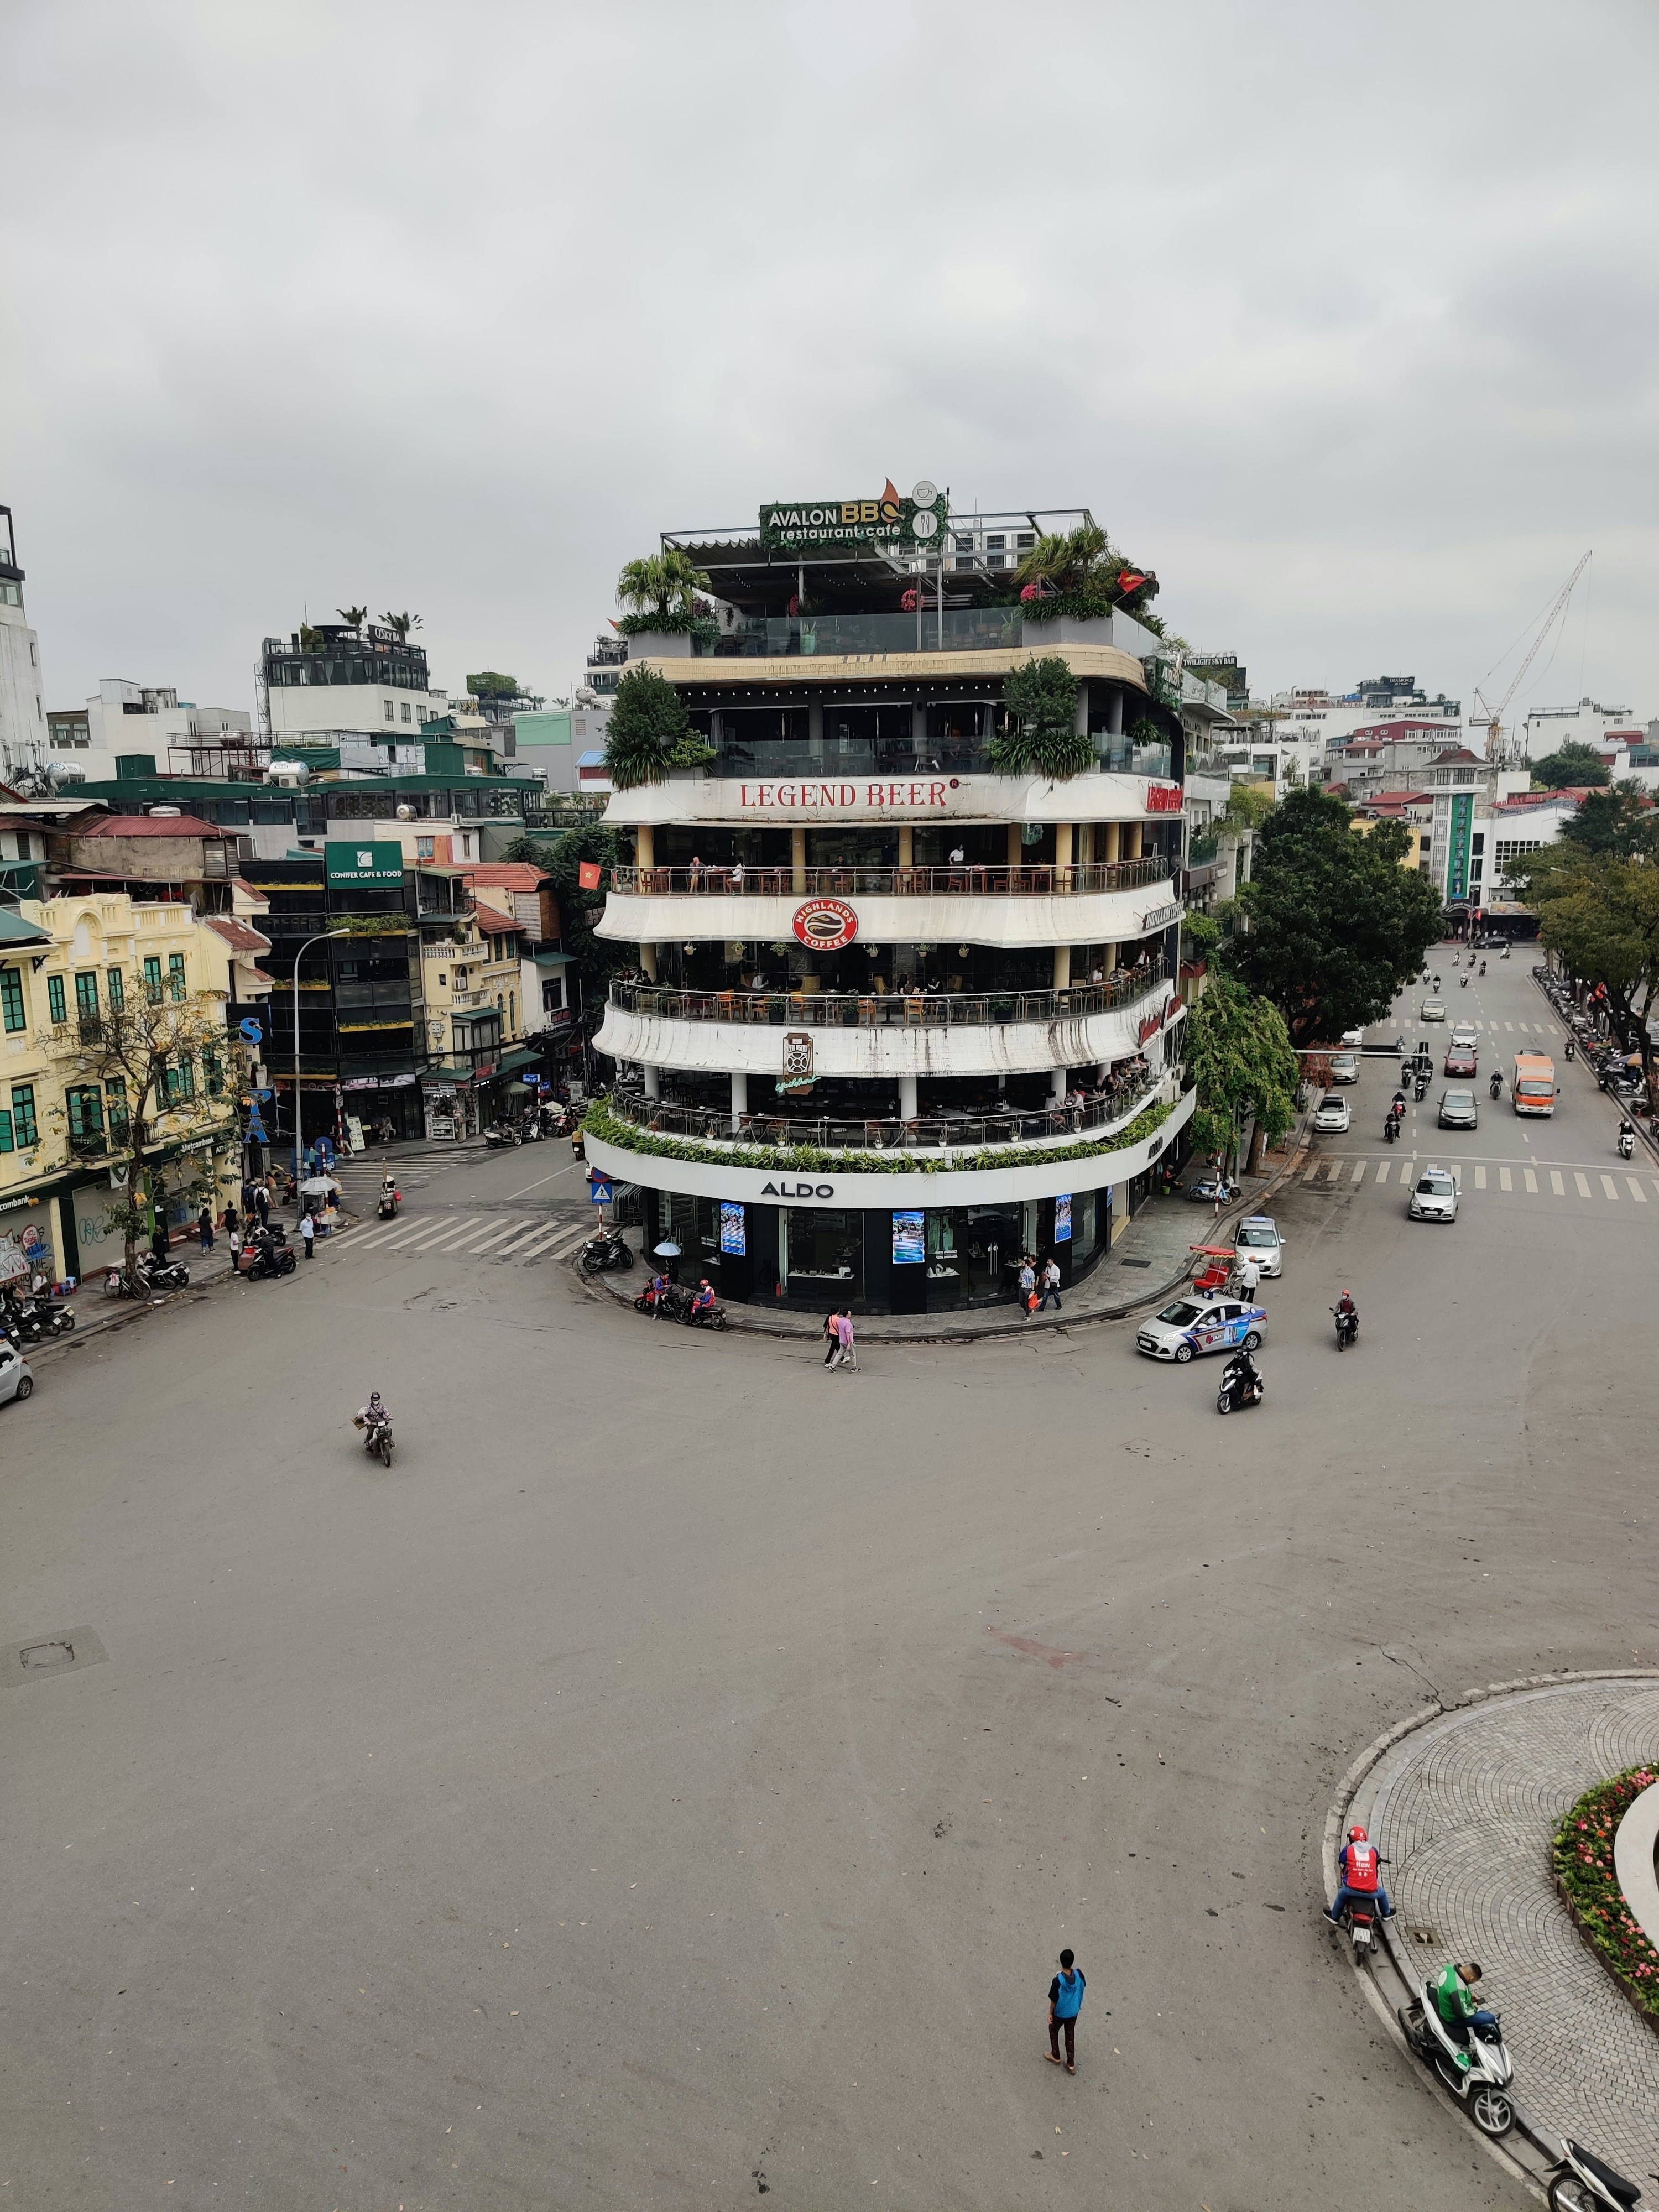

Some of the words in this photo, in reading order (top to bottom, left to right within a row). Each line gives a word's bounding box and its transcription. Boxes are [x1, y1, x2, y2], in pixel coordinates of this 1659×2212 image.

[769, 509, 837, 527] AVALON
[740, 785, 856, 807] LEGEND
[866, 782, 946, 807] BEER
[796, 902, 854, 924] HIGHLANDS
[804, 935, 848, 948] COFFEE
[181, 1136, 215, 1152] Vietcombank
[761, 1181, 834, 1198] ALDO
